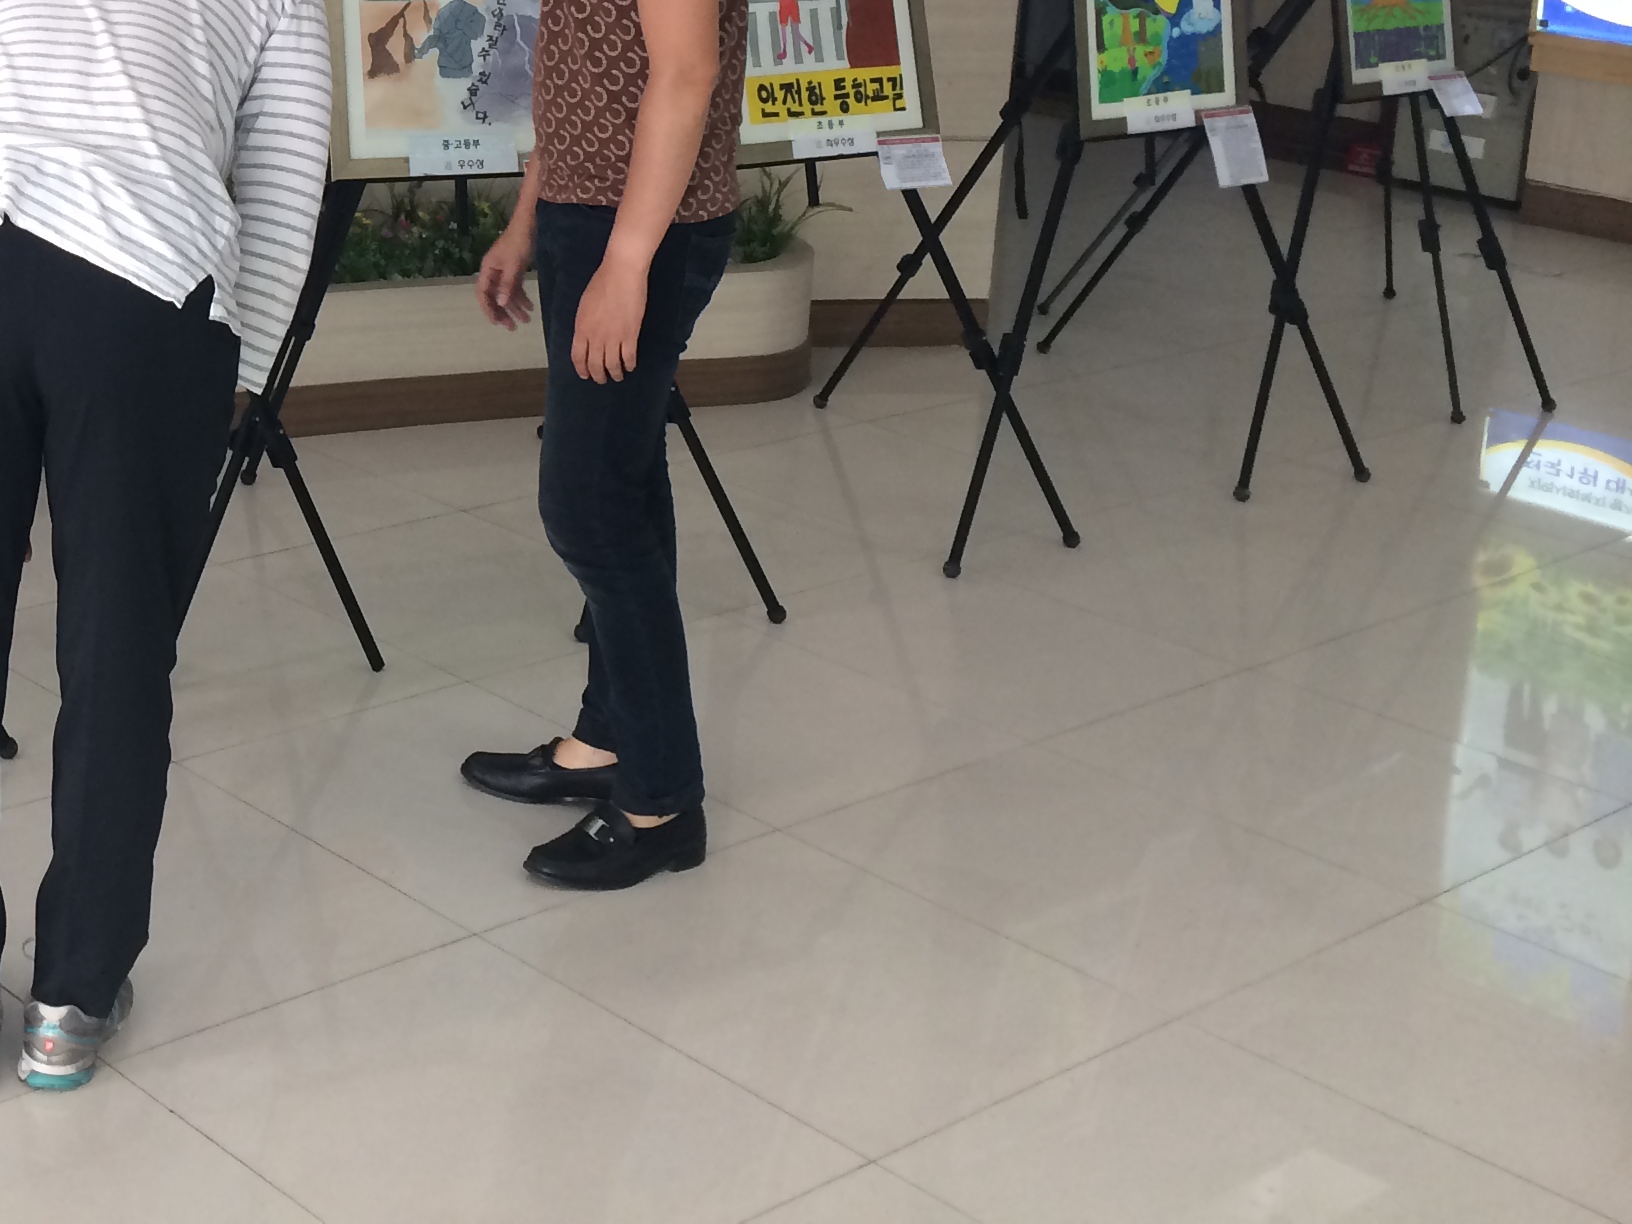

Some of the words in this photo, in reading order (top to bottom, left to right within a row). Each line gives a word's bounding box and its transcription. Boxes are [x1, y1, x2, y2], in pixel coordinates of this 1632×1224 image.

[485, 7, 508, 50] 달라질
[477, 47, 491, 62] 수
[757, 79, 829, 119] 안전한
[833, 73, 907, 114] 등하교길
[457, 158, 485, 170] 우수상
